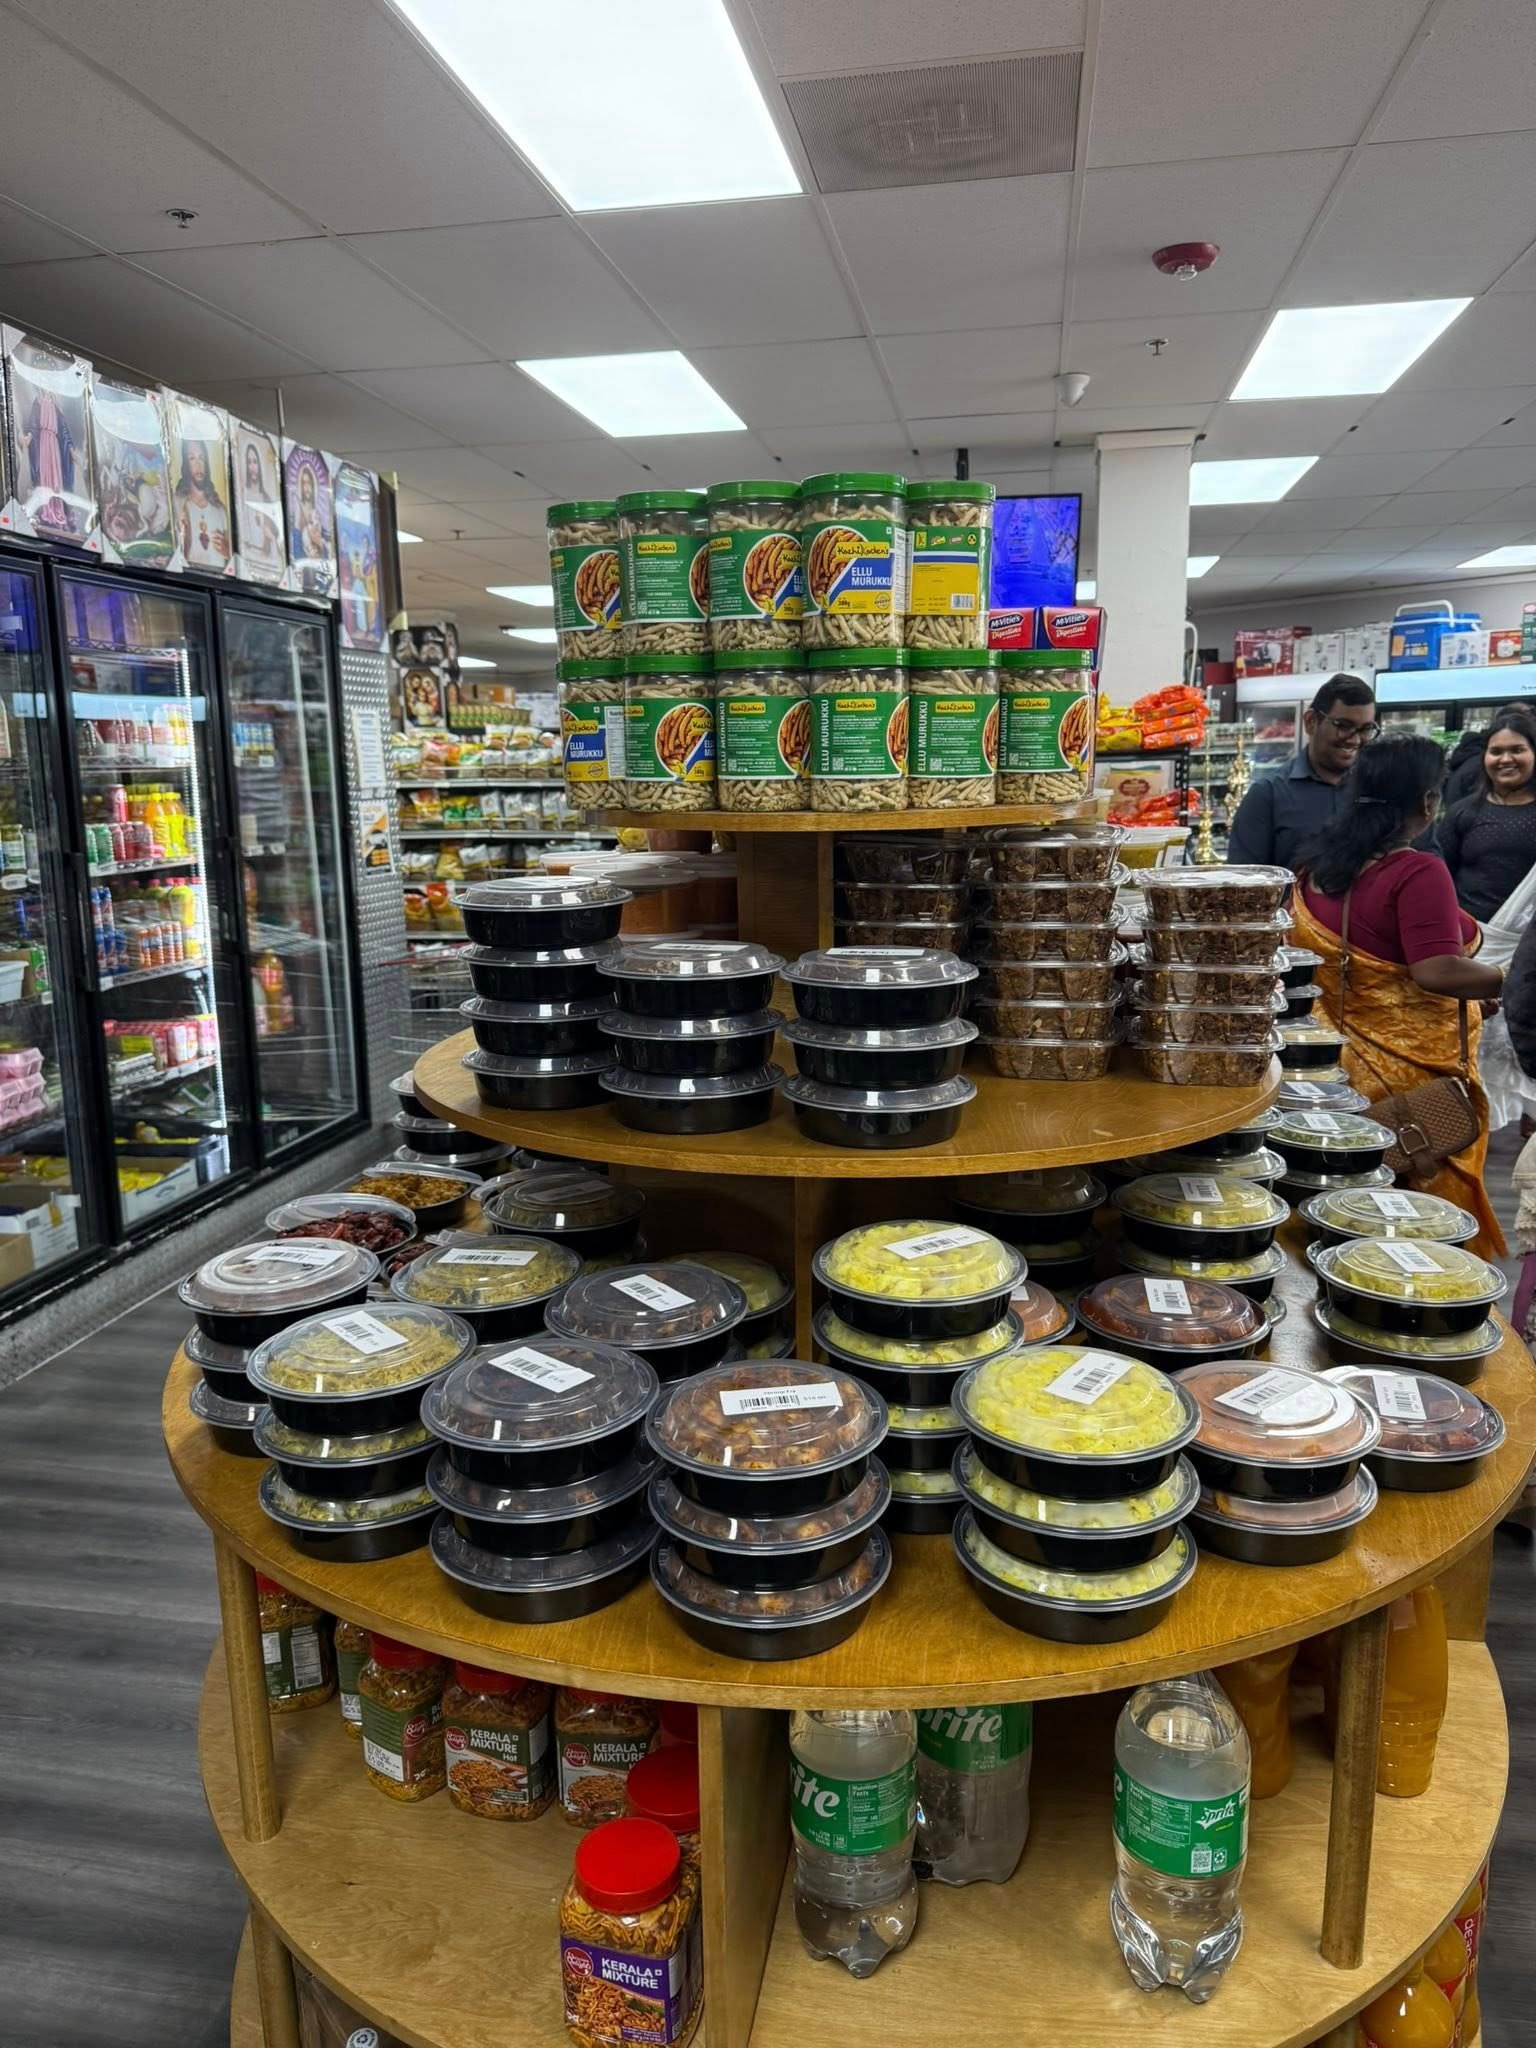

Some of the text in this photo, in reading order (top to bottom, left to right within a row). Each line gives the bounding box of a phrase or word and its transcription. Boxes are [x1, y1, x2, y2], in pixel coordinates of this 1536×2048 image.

[851, 567, 872, 576] ELLU
[851, 576, 893, 586] MURUKKU
[1000, 698, 1008, 743] MURUKKU
[821, 699, 829, 771] ELLU MURUKKU
[918, 701, 928, 771] ELLU MURUKKU
[569, 742, 584, 750] ELLU
[570, 750, 603, 758] MURUKKU
[470, 1728, 510, 1743] KERALA
[470, 1738, 518, 1754] MIXTURE
[593, 1743, 638, 1752] KERALA
[502, 1753, 517, 1761] Hot
[852, 1783, 878, 1791] Nutrition
[1200, 1802, 1236, 1823] Sprite
[601, 1958, 653, 1978] KERALA
[601, 1968, 659, 1990] MIXTURE
